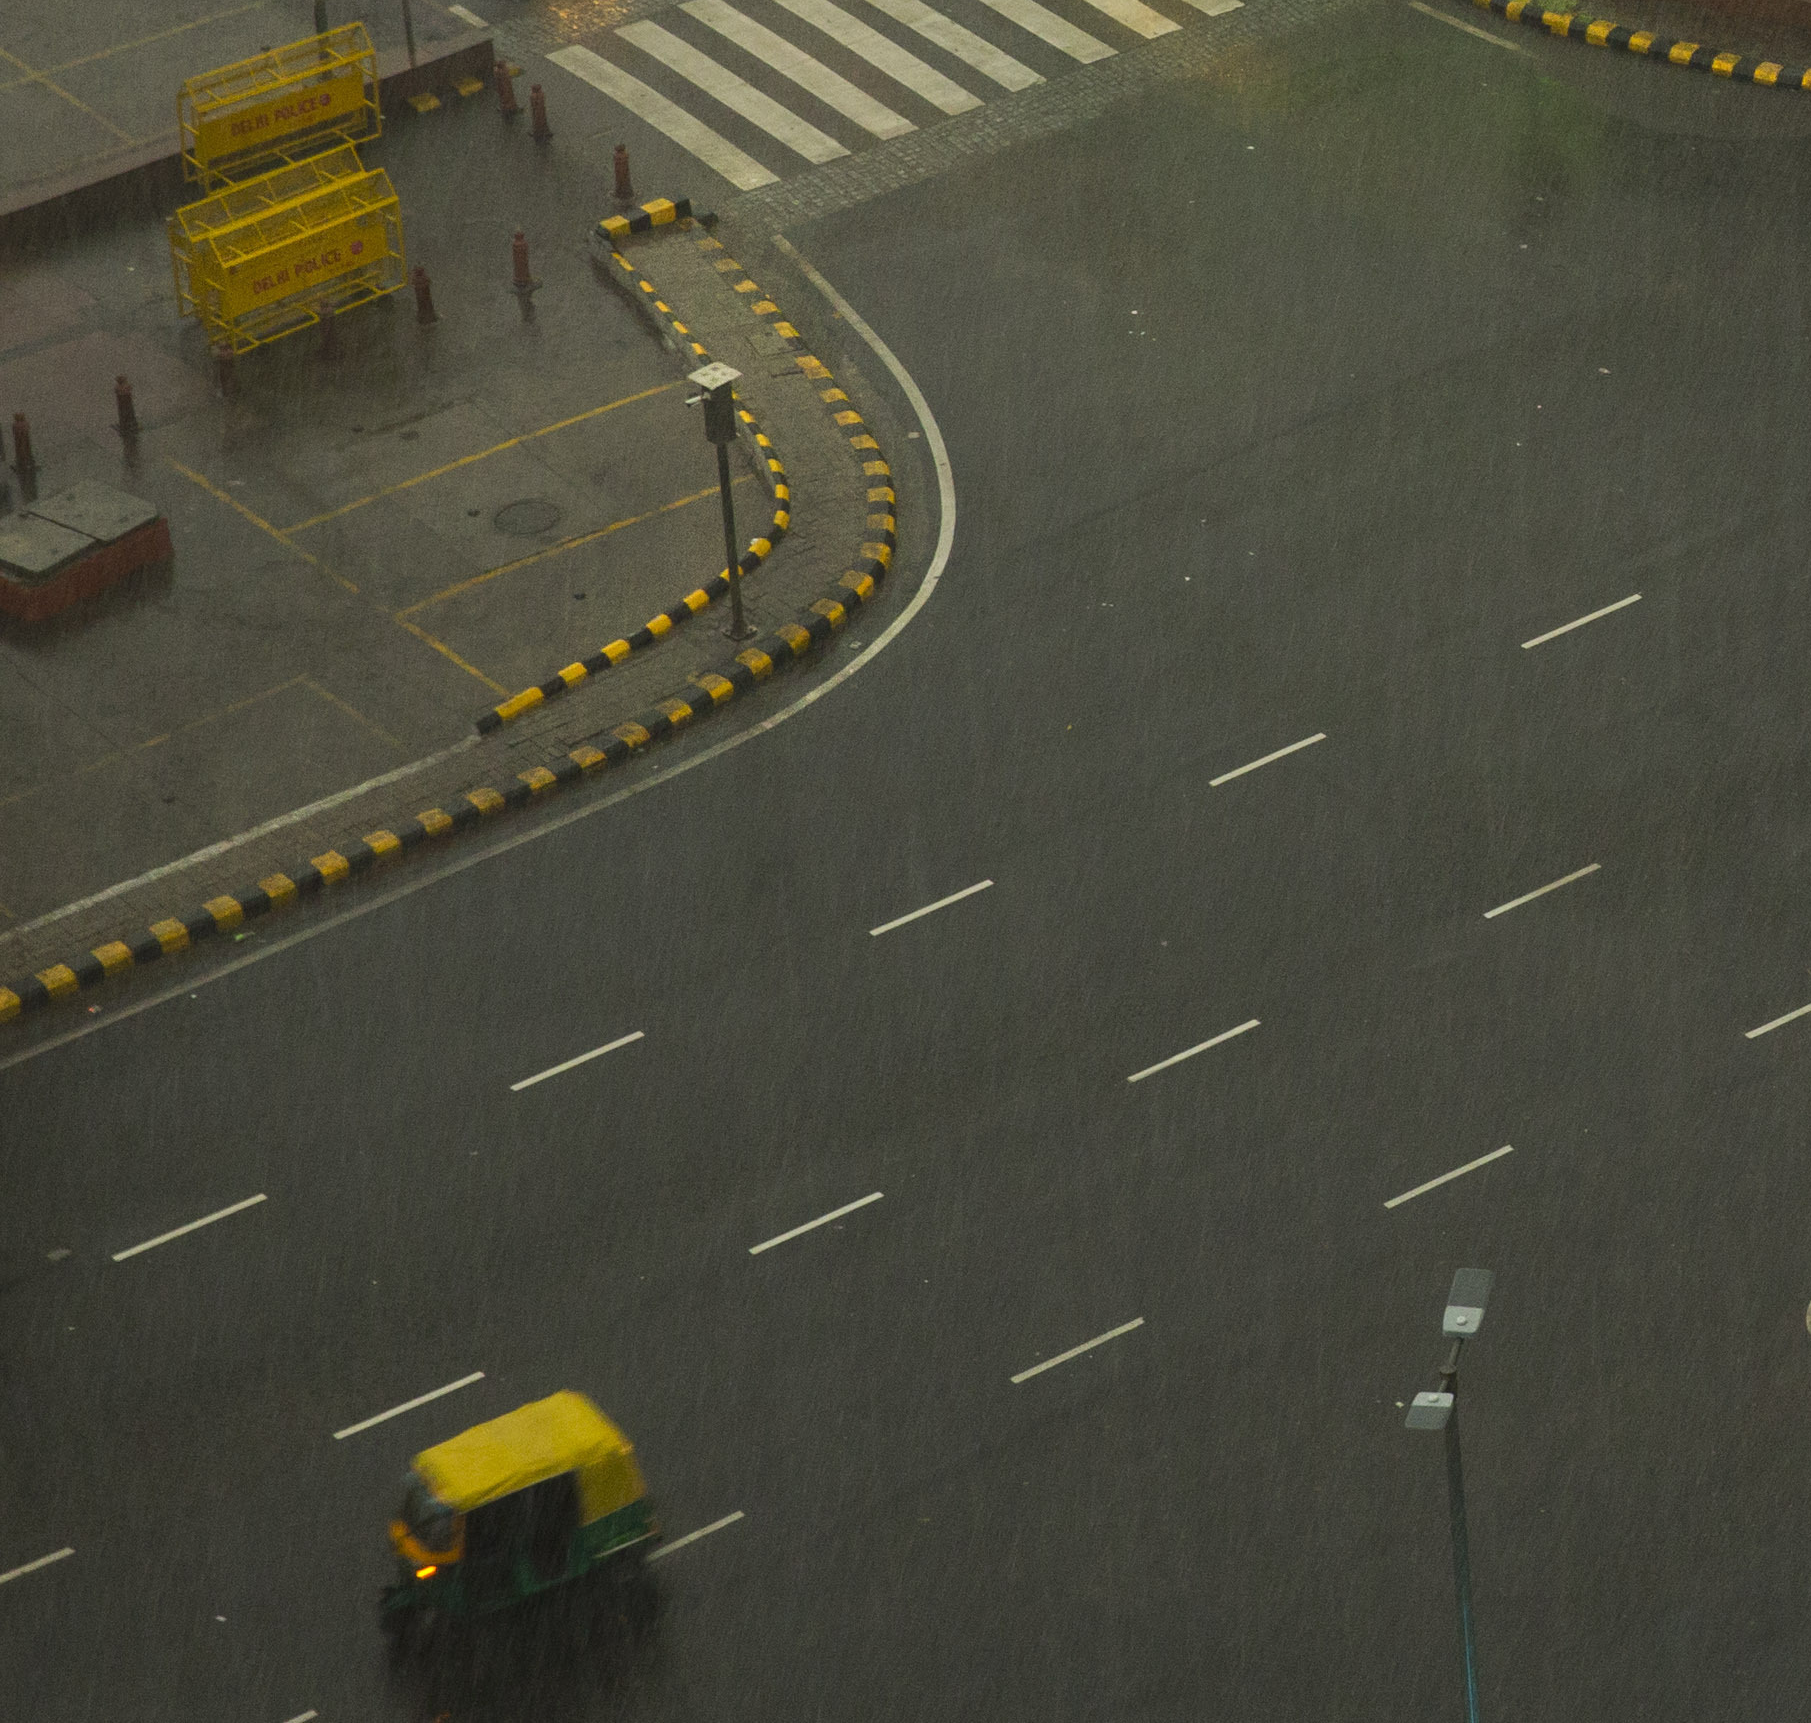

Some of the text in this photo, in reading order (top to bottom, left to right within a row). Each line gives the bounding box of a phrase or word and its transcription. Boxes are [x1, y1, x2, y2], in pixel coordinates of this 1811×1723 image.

[230, 97, 317, 137] DELHI POLICE
[252, 251, 341, 294] DELHI POLICE
